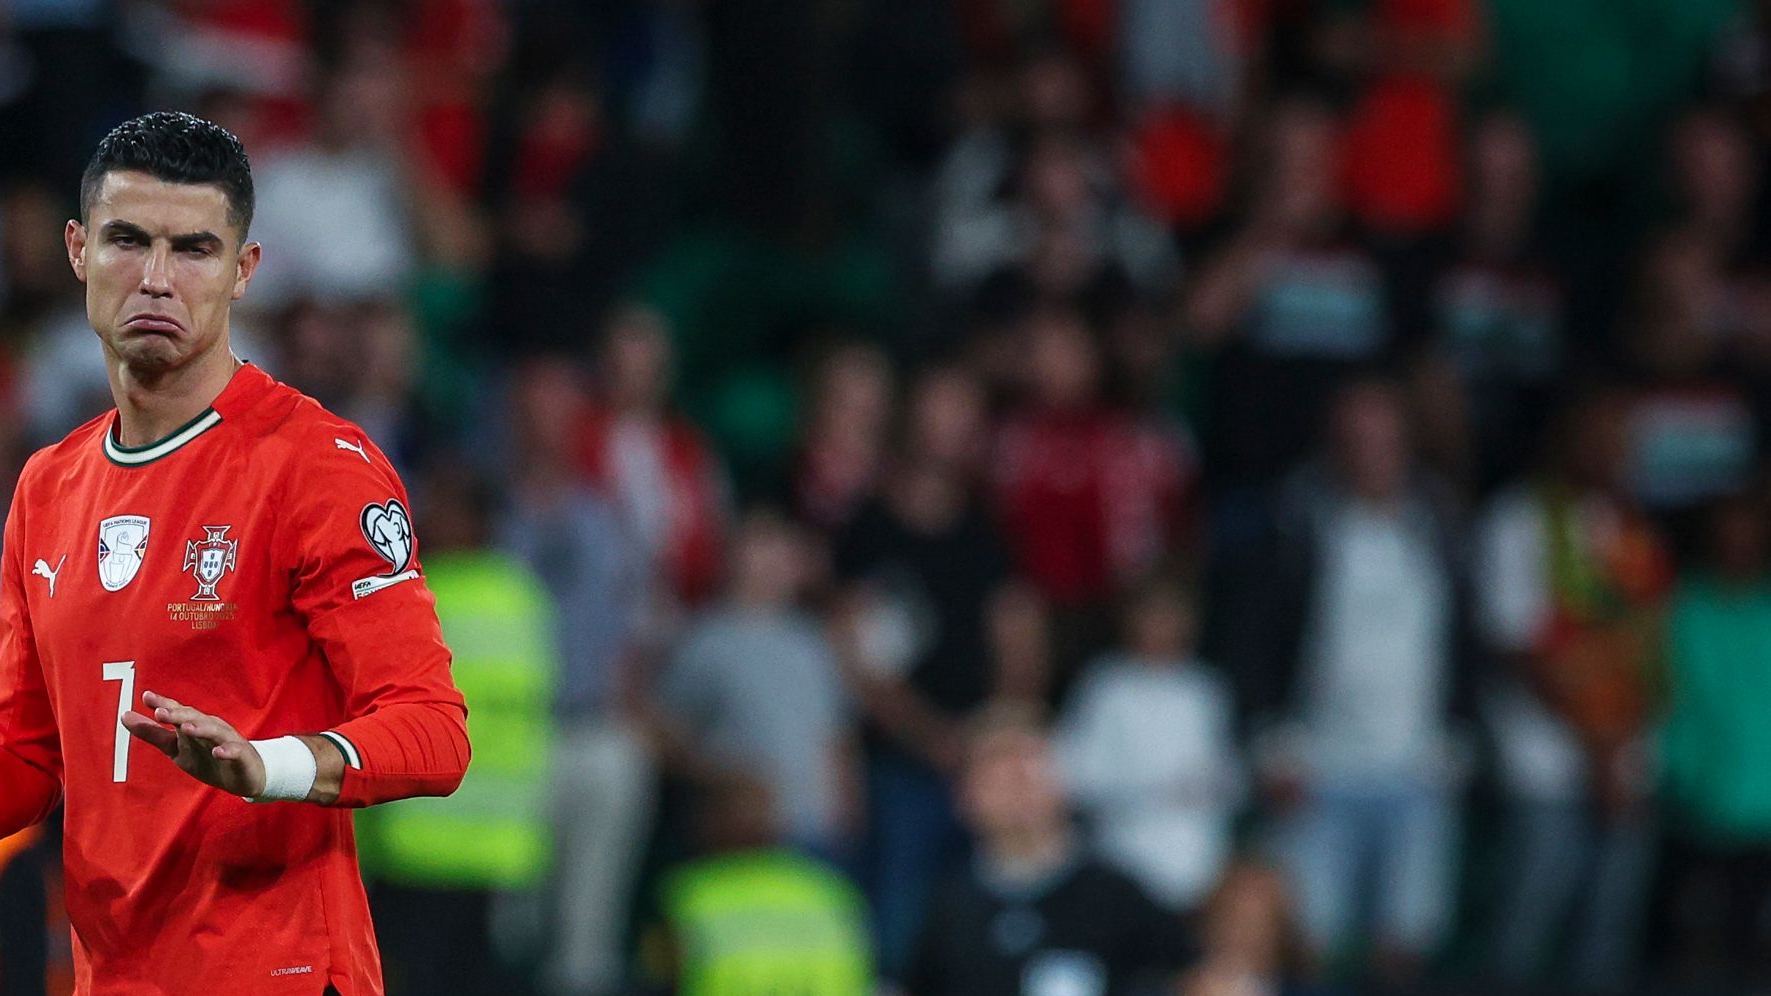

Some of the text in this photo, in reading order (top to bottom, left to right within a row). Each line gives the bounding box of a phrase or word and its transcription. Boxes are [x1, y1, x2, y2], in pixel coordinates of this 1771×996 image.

[354, 581, 371, 590] UEFA
[170, 612, 177, 621] 14
[179, 612, 213, 621] OUTUBRO
[102, 660, 135, 782] 7
[270, 965, 313, 977] ULTRAWEAVE
